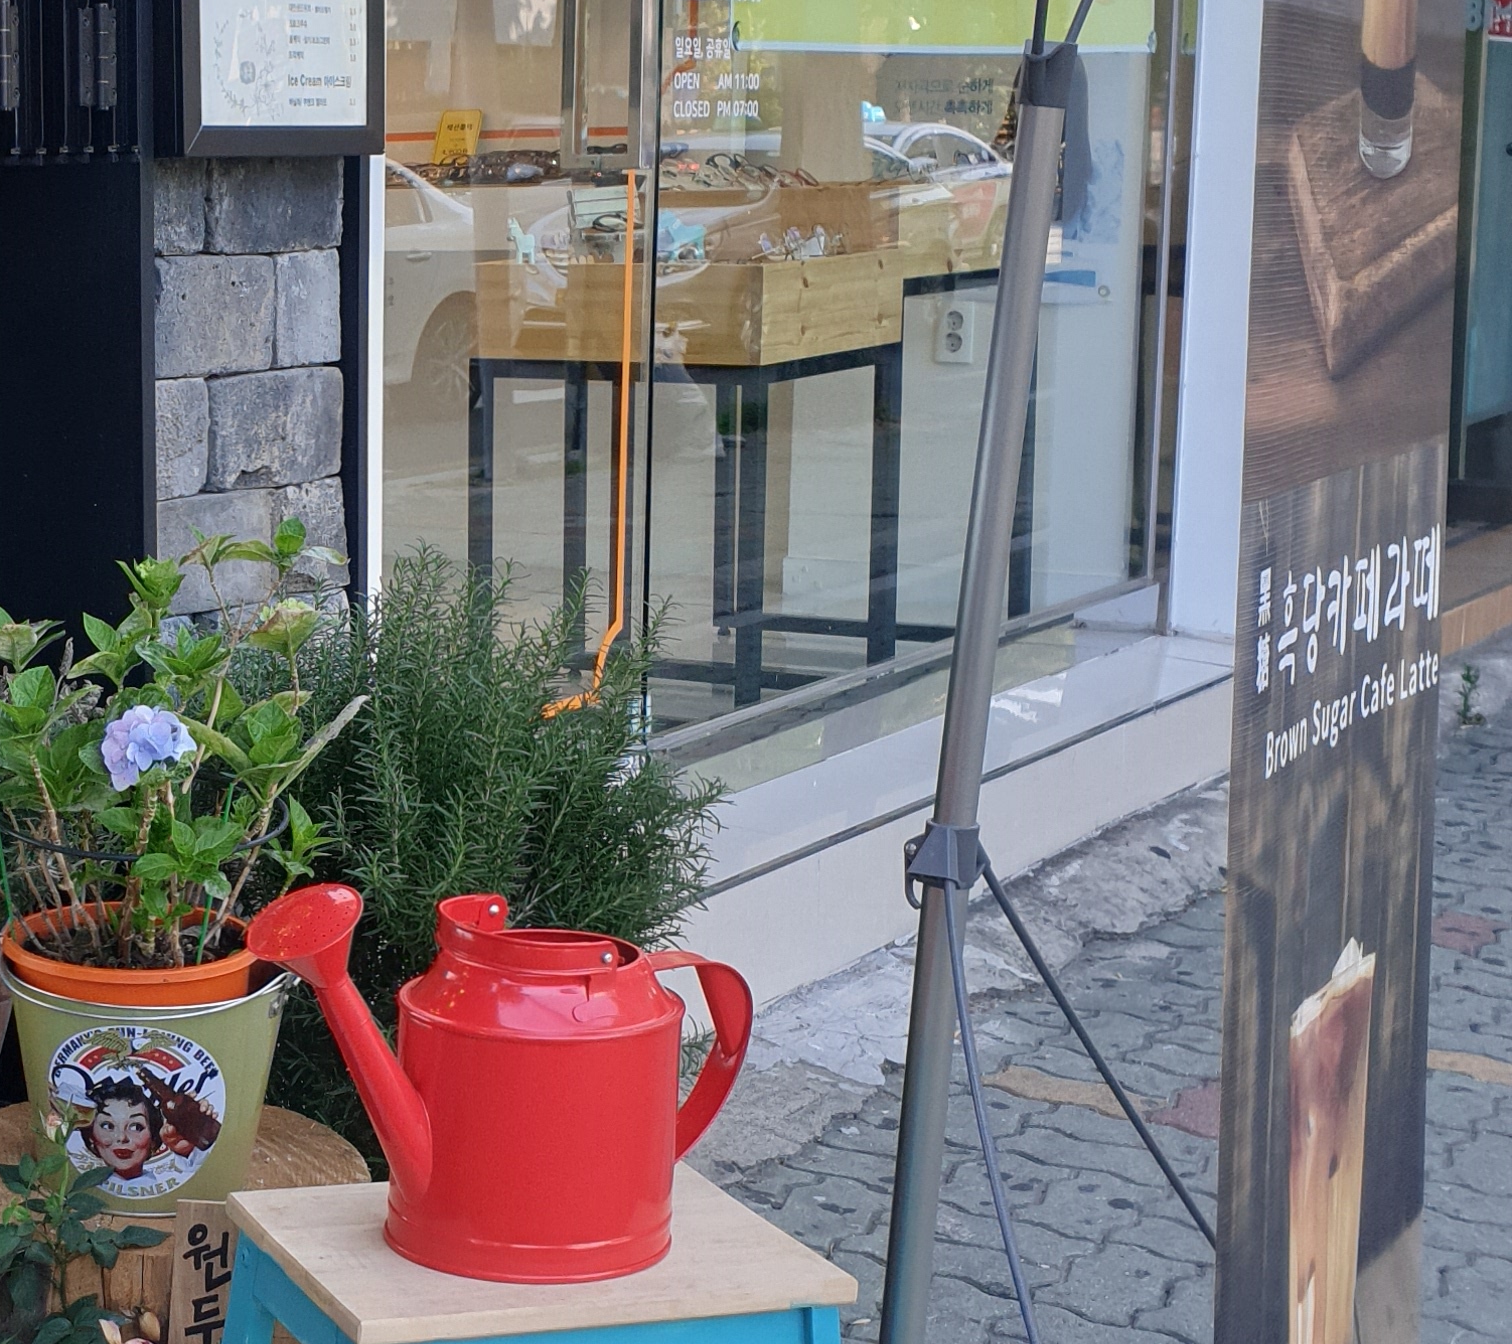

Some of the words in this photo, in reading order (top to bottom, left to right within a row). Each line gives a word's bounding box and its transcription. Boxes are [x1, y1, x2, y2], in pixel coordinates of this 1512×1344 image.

[705, 37, 732, 59] 공휴일
[287, 74, 298, 87] Ice
[300, 74, 322, 87] Cream
[674, 72, 700, 90] OPEN
[717, 73, 732, 90] AM
[734, 73, 760, 90] 11:00
[673, 100, 710, 118] CLOSED
[717, 100, 731, 118] PM
[733, 100, 759, 118] 07:00
[1278, 522, 1441, 686] 흑당카페라떼
[1264, 716, 1308, 780] Brown
[1312, 690, 1357, 748] Sugar
[1360, 663, 1395, 718] Cafe
[1400, 650, 1439, 700] Latte
